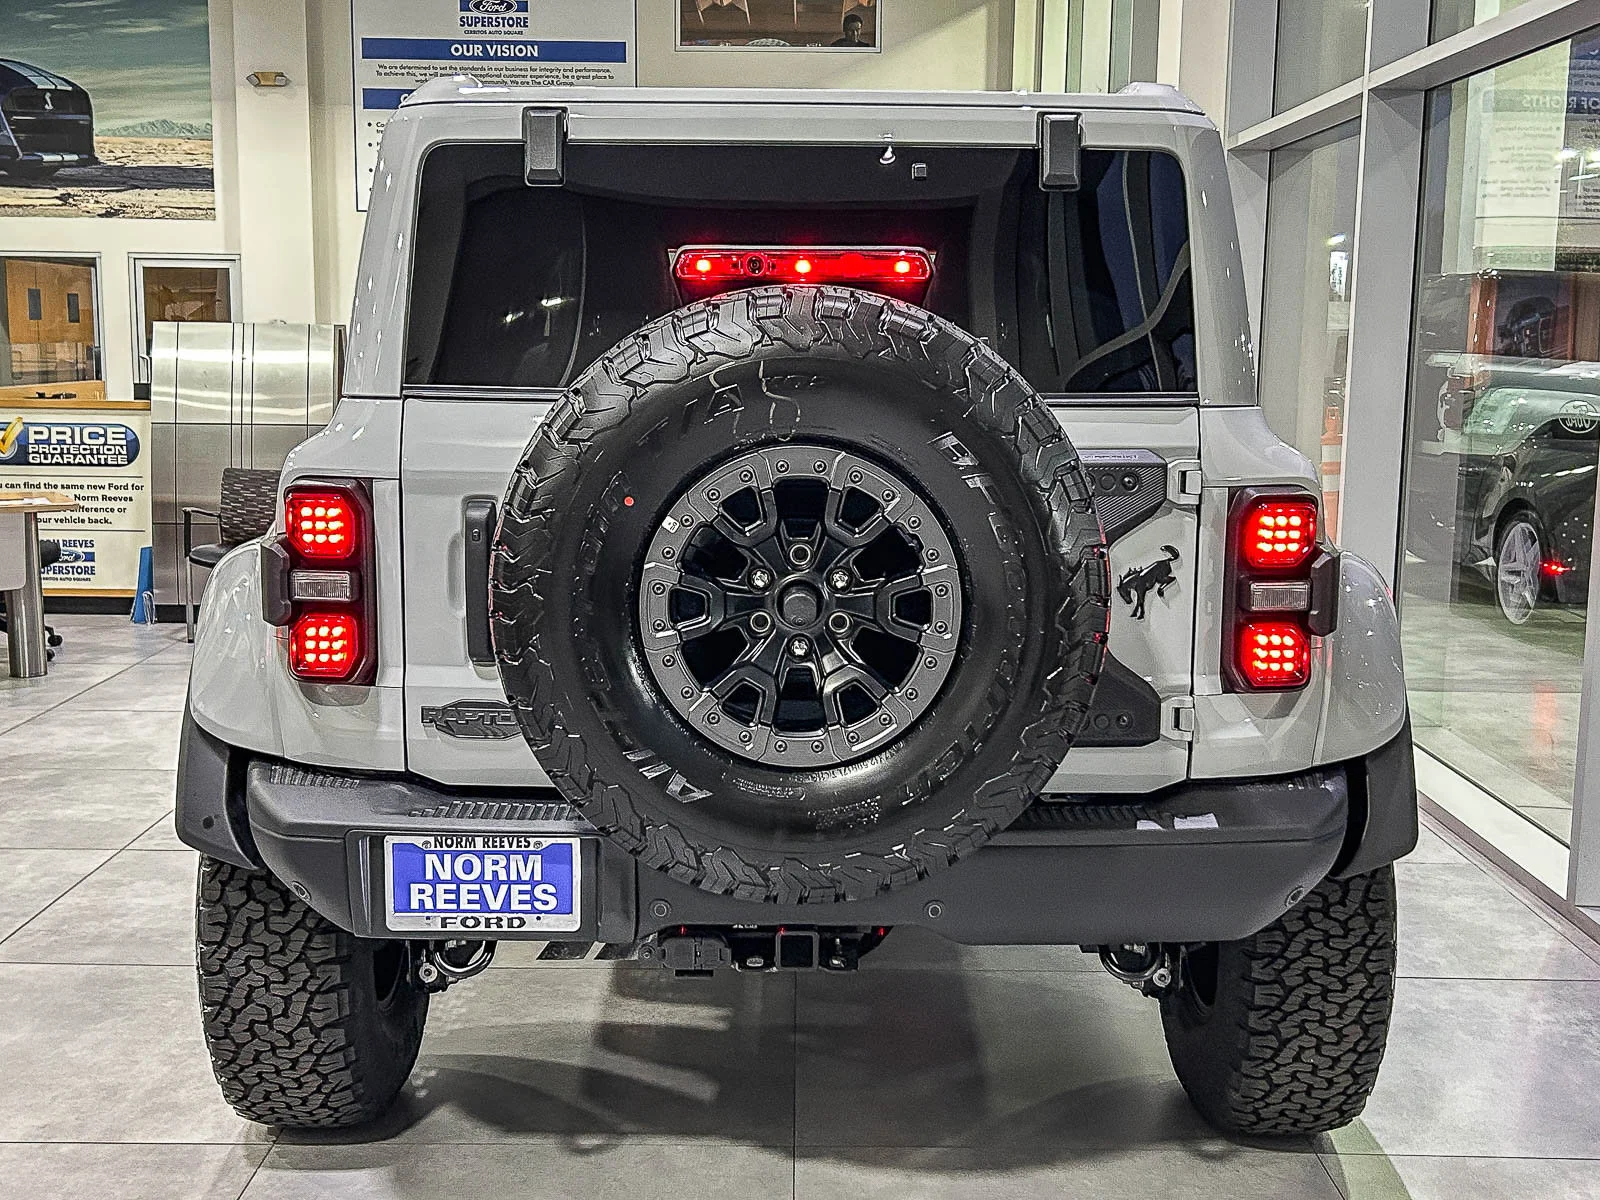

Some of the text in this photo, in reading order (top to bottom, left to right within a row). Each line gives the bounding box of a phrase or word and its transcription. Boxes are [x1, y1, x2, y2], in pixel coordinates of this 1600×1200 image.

[480, 0, 508, 11] Ford
[459, 16, 529, 28] SUPERSTORE
[451, 44, 539, 57] OUR VISION
[28, 426, 127, 445] PRICE
[28, 444, 128, 455] PROTECTION
[28, 454, 128, 465] GUARANTEE
[131, 483, 144, 491] for
[74, 494, 133, 502] Norm Reeves
[54, 516, 86, 524] vehicle
[62, 539, 95, 548] REEVES
[40, 566, 96, 575] UPERSTORE
[421, 706, 517, 725] RAPTO
[434, 836, 531, 849] NORM REEVES
[424, 853, 543, 881] NORM
[409, 883, 558, 912] REEVES
[440, 916, 526, 929] FORD
